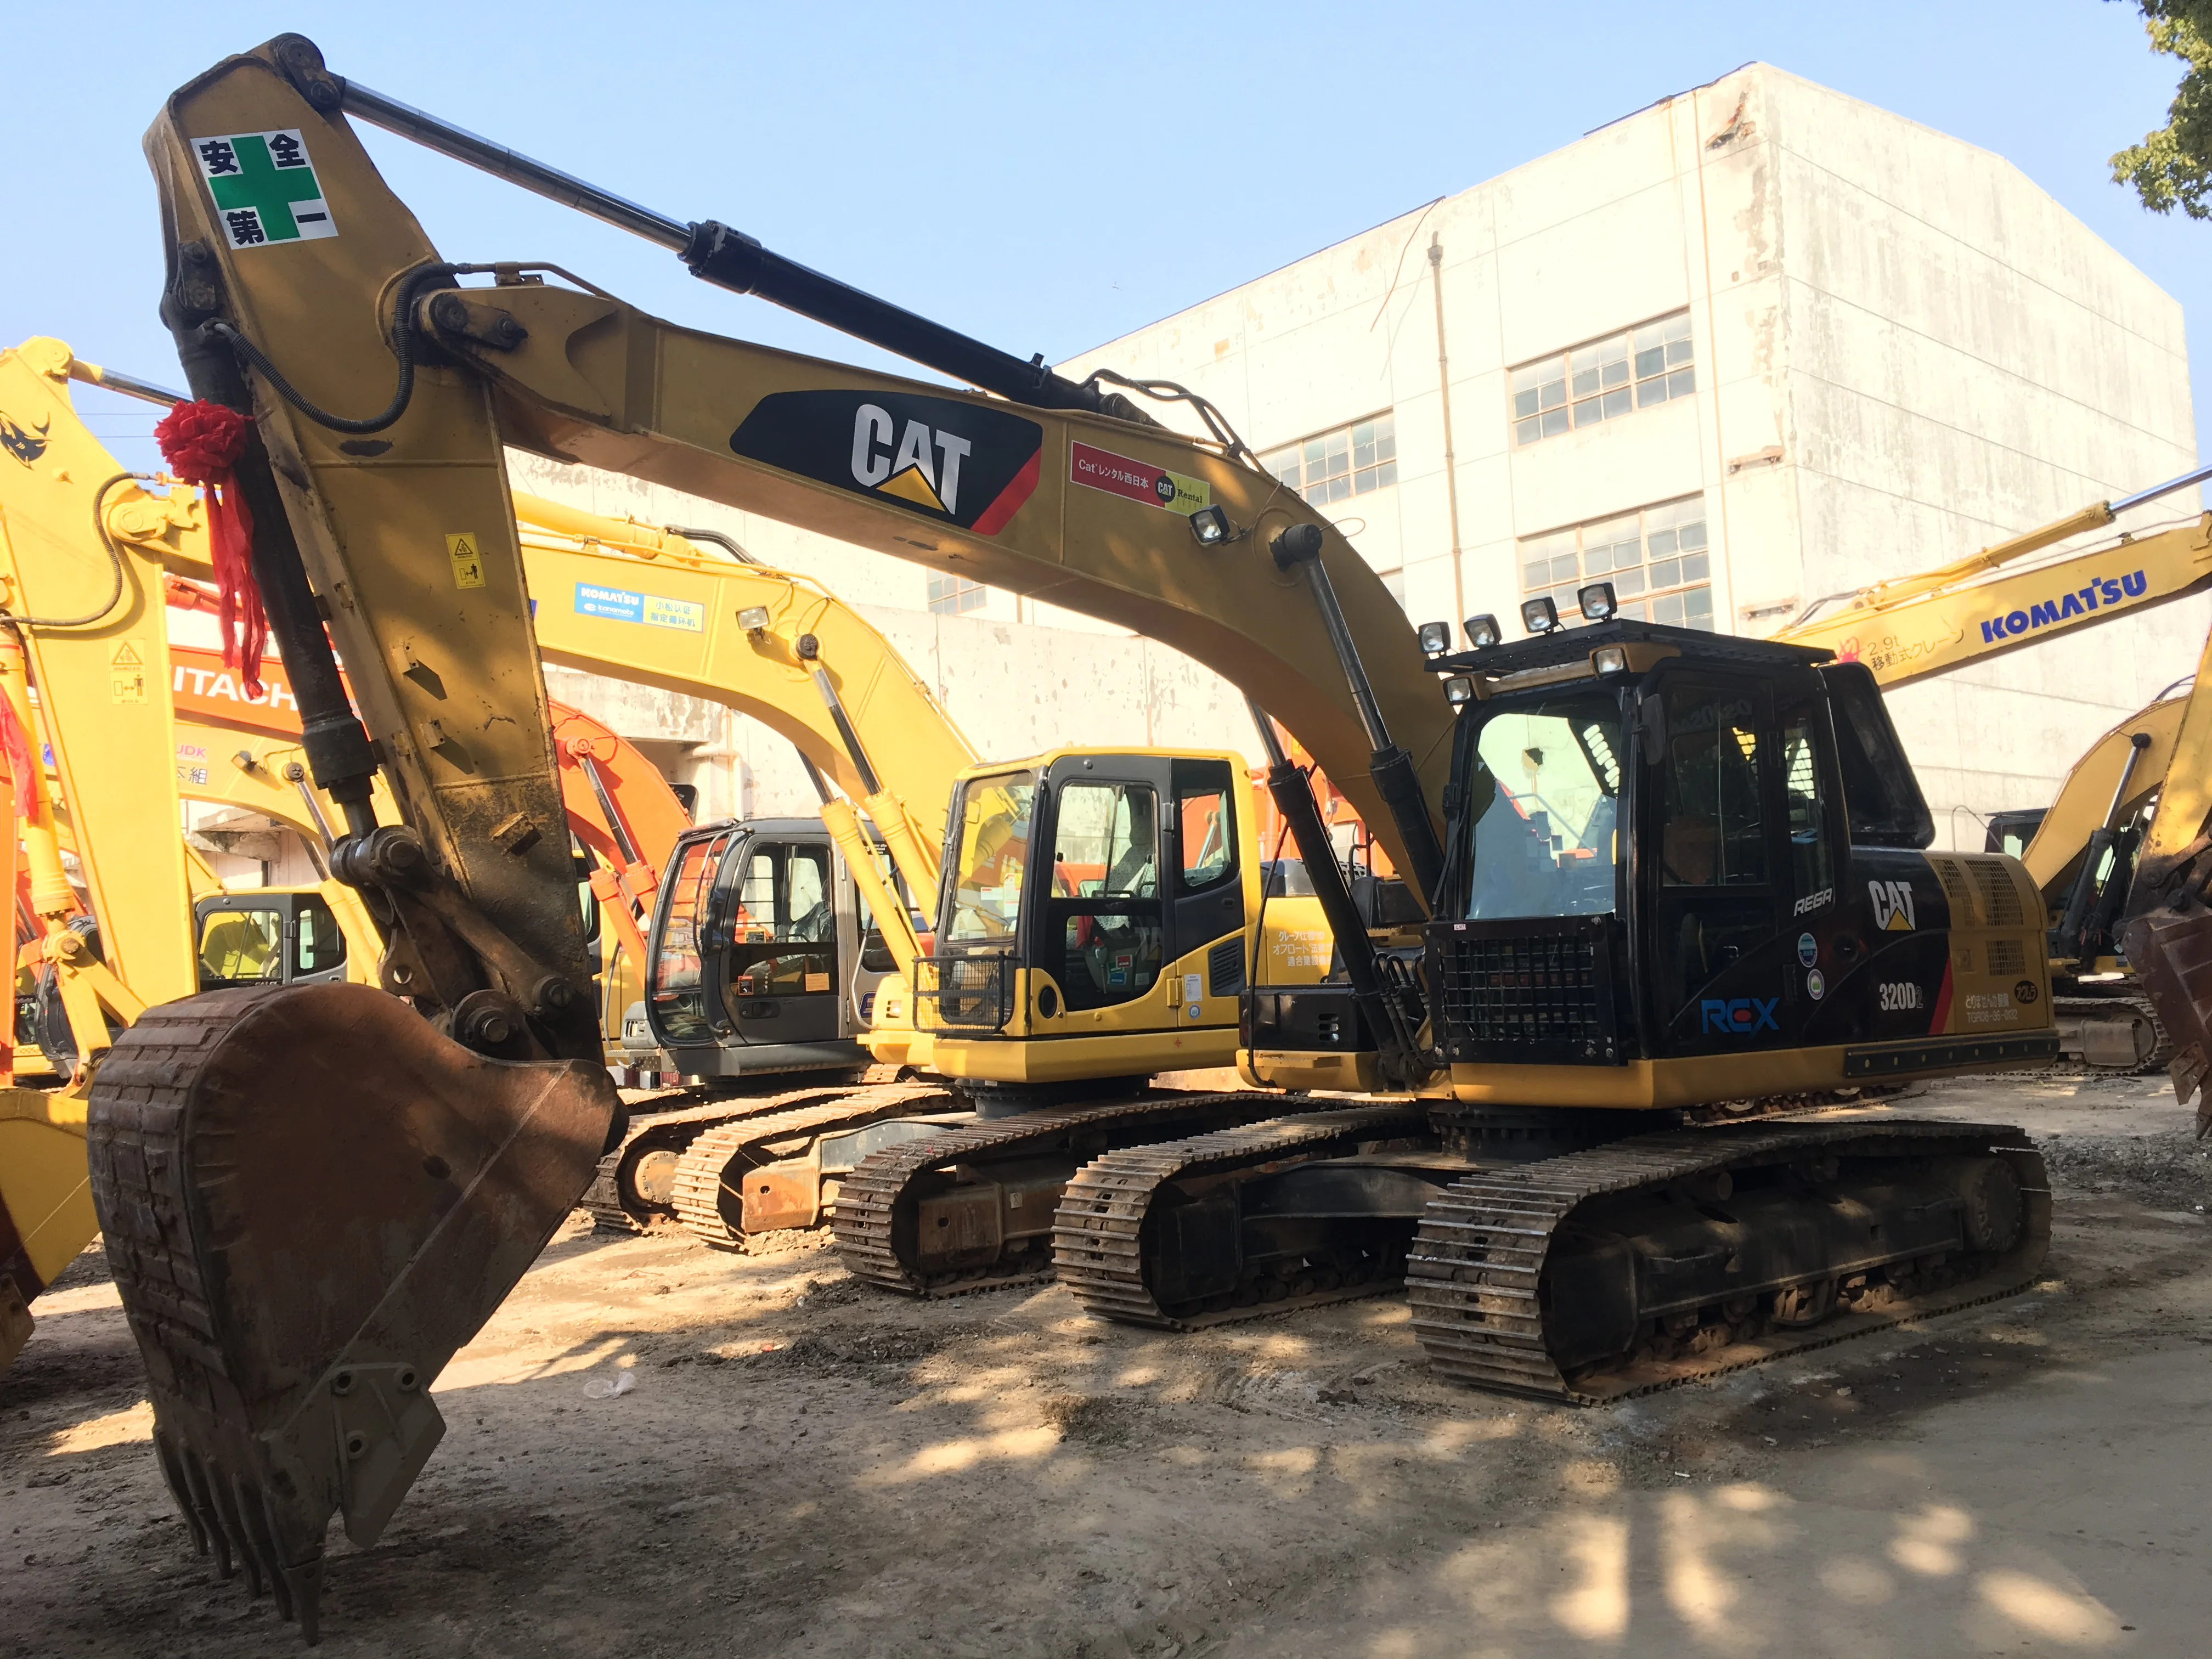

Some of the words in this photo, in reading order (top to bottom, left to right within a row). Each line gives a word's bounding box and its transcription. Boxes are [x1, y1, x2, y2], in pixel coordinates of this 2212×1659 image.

[851, 404, 971, 515] CAT
[1099, 464, 1149, 489] レンタル西日本
[1158, 481, 1173, 496] CAT
[1177, 488, 1203, 504] Rental
[581, 587, 640, 606] KOMATSU
[656, 601, 692, 615] 小松认证
[1980, 569, 2147, 644] KOMATSU
[1867, 635, 1900, 657] 2.9t
[1793, 888, 1833, 917] REGA
[1868, 880, 1916, 931] CAT
